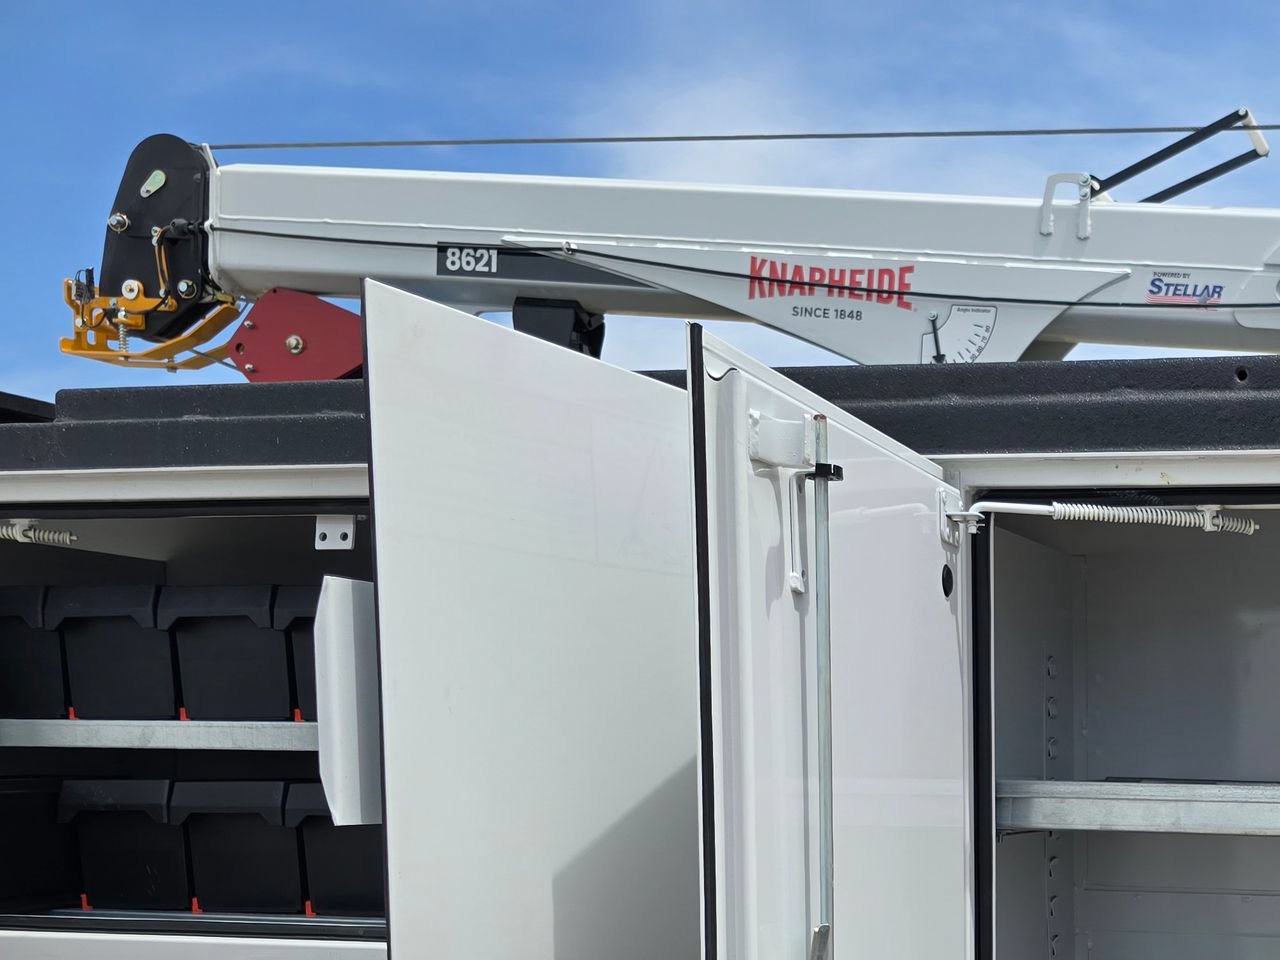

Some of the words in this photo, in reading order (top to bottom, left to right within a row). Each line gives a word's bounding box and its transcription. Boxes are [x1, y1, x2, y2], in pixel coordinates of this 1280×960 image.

[446, 248, 498, 273] 8621
[748, 255, 915, 311] KNAPHEIDE
[1153, 271, 1181, 279] POWERED
[1148, 278, 1224, 299] STELLAR
[792, 306, 831, 319] SINCE
[834, 309, 863, 321] 1848
